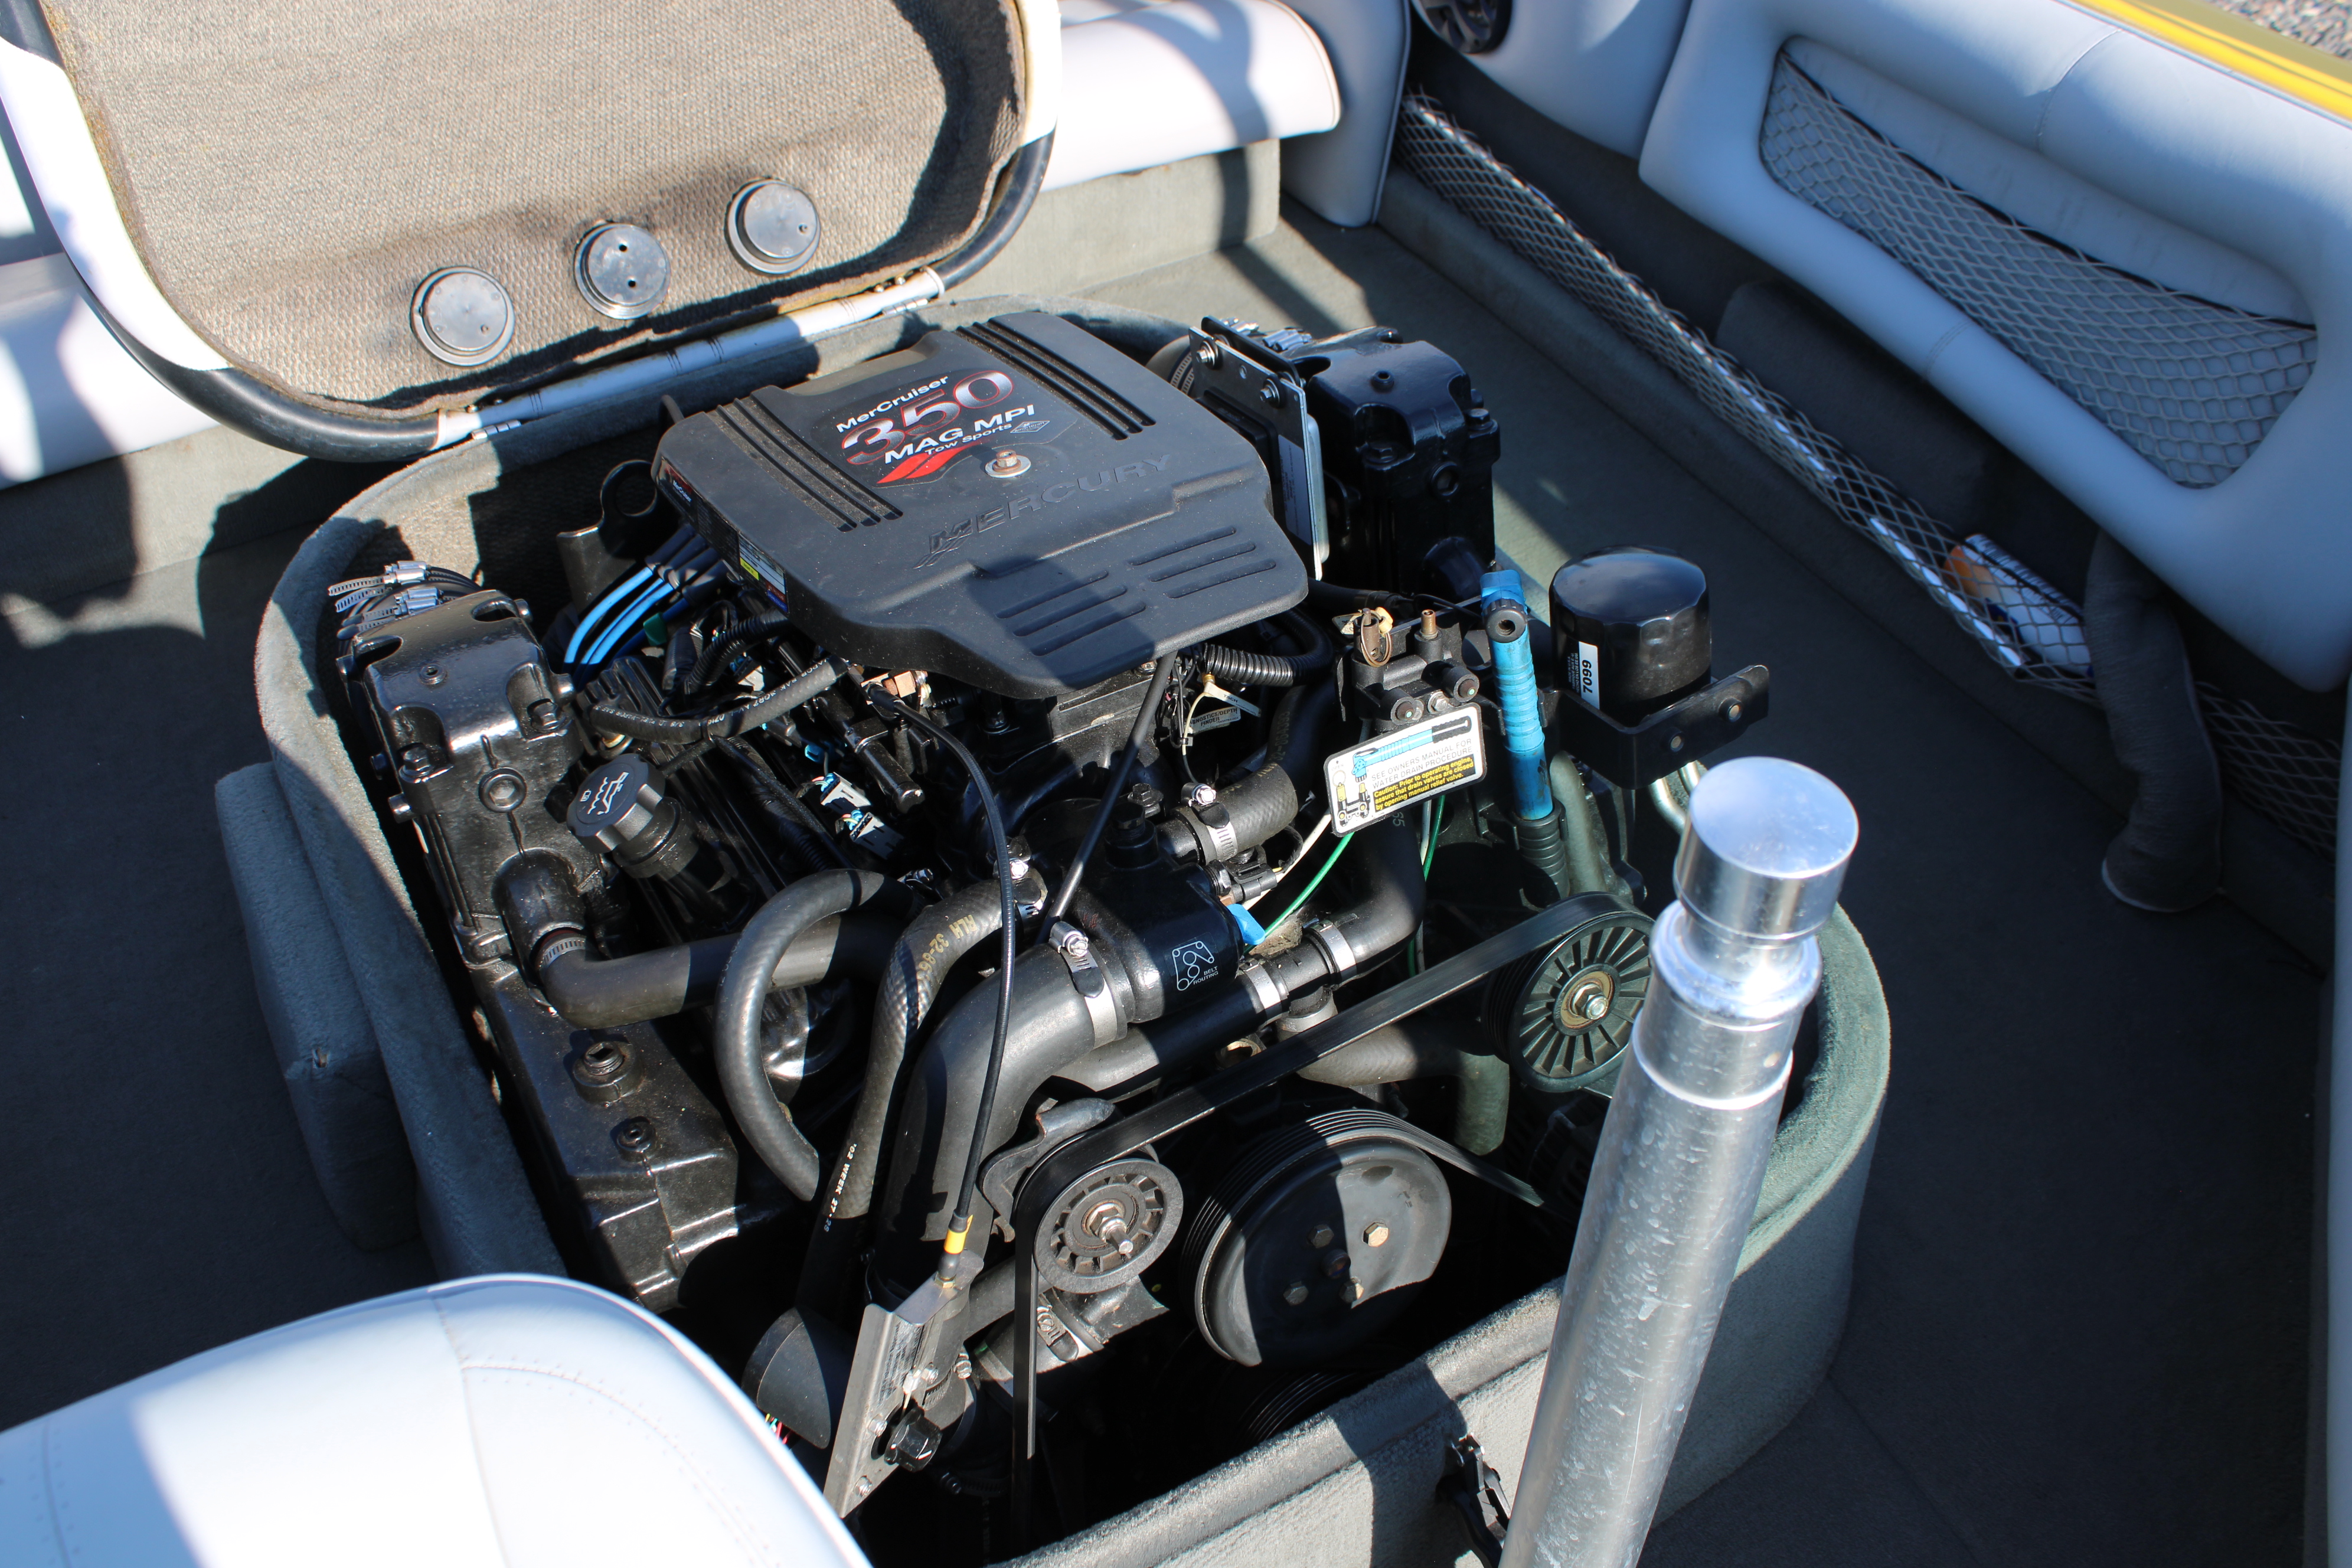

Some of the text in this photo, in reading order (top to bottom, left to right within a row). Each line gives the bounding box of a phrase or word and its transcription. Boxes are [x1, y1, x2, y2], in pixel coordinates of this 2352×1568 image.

[837, 375, 948, 433] MerCruiser
[841, 370, 1014, 465] 350
[885, 404, 1035, 464] MAG MPI
[925, 423, 1012, 456] Tow Sports
[920, 454, 1171, 558] MERCURY
[1582, 659, 1592, 693] 7099
[1223, 694, 1238, 703] TACH
[1201, 717, 1220, 727] FINDER
[1331, 763, 1344, 772] OPEN
[1371, 739, 1471, 781] SEE OWNERS MANUAL FOR
[1373, 747, 1472, 789] WATER DRAIN PROCEDURE
[1374, 784, 1398, 798] Caution:
[1399, 778, 1413, 788] Prior
[1422, 764, 1449, 779] operating
[1450, 757, 1472, 769] engine,
[1375, 793, 1394, 804] assure
[1407, 781, 1423, 790] drain
[1423, 775, 1442, 785] valves
[1453, 762, 1474, 773] closed
[1376, 773, 1464, 811] by opening manual relief valve.
[949, 914, 978, 939] RLH
[1193, 971, 1219, 985] ROUTING
[1204, 966, 1217, 976] BELT
[835, 1163, 850, 1195] WEEK
